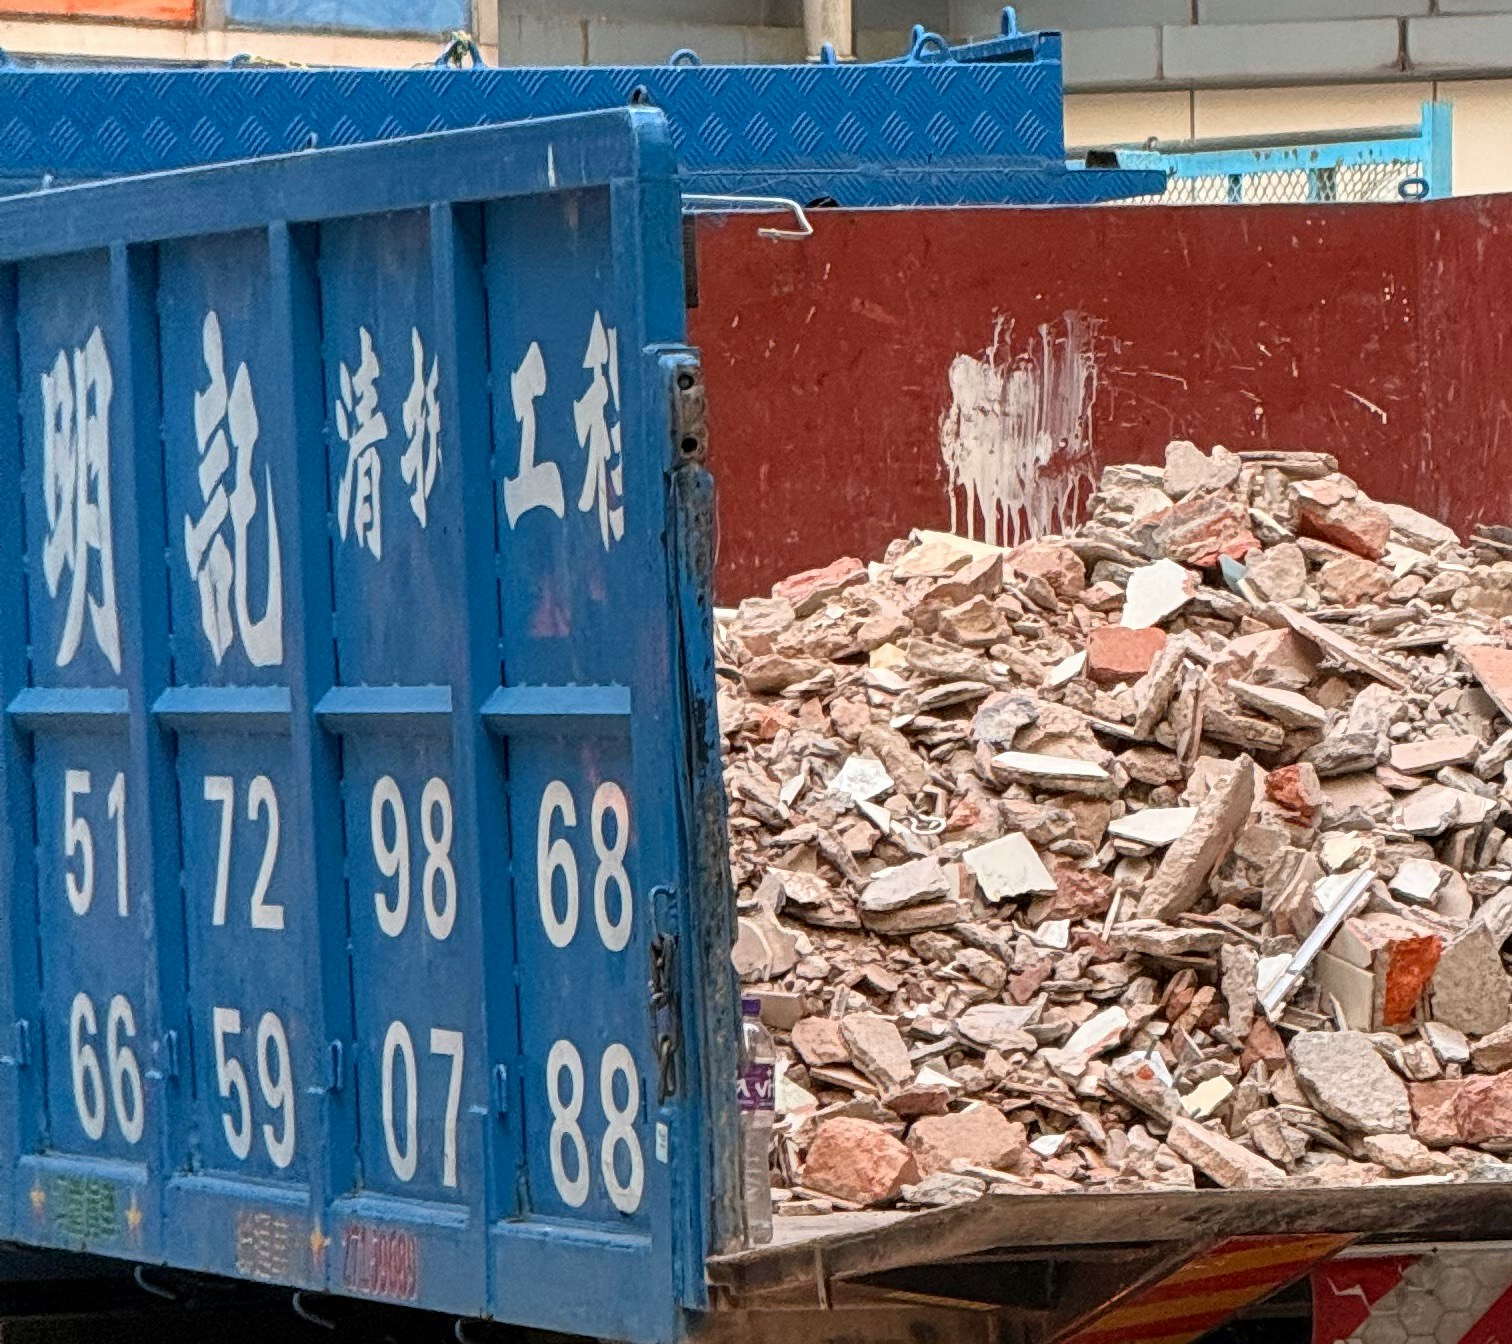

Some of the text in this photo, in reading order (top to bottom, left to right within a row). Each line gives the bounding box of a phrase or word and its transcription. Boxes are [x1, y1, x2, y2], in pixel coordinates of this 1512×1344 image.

[64, 770, 634, 952] 51 72 98 68
[70, 992, 644, 1214] 66 59 07 88
